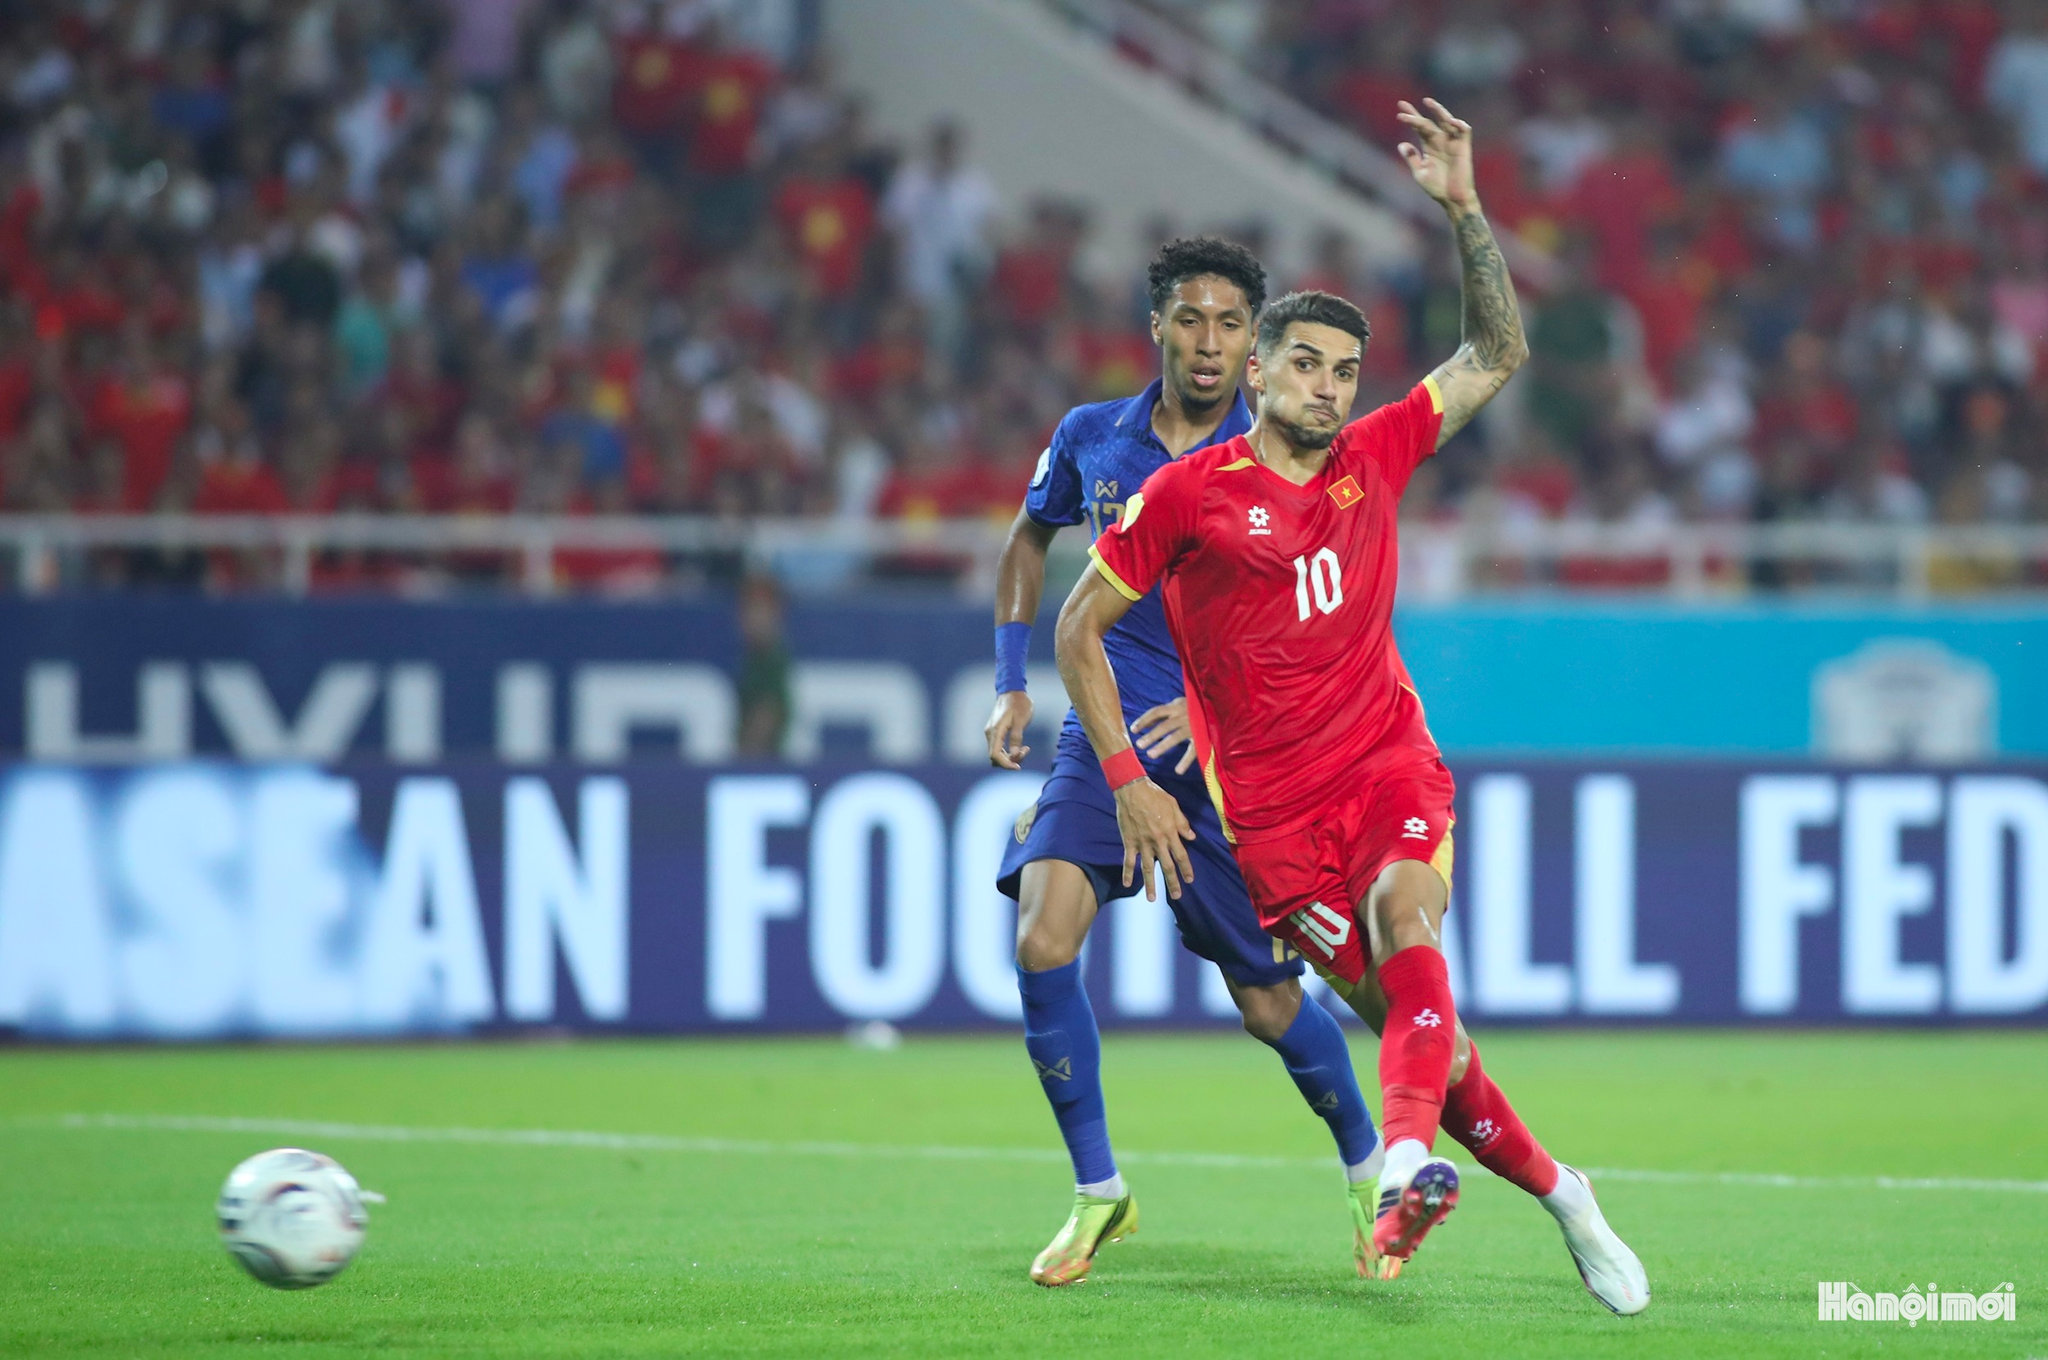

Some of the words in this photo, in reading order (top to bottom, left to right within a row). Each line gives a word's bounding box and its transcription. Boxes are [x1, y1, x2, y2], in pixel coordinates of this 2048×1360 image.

[1293, 546, 1343, 622] 10
[0, 768, 630, 1030] ASEAN
[1738, 774, 2048, 1015] FED
[1289, 901, 1351, 960] 10
